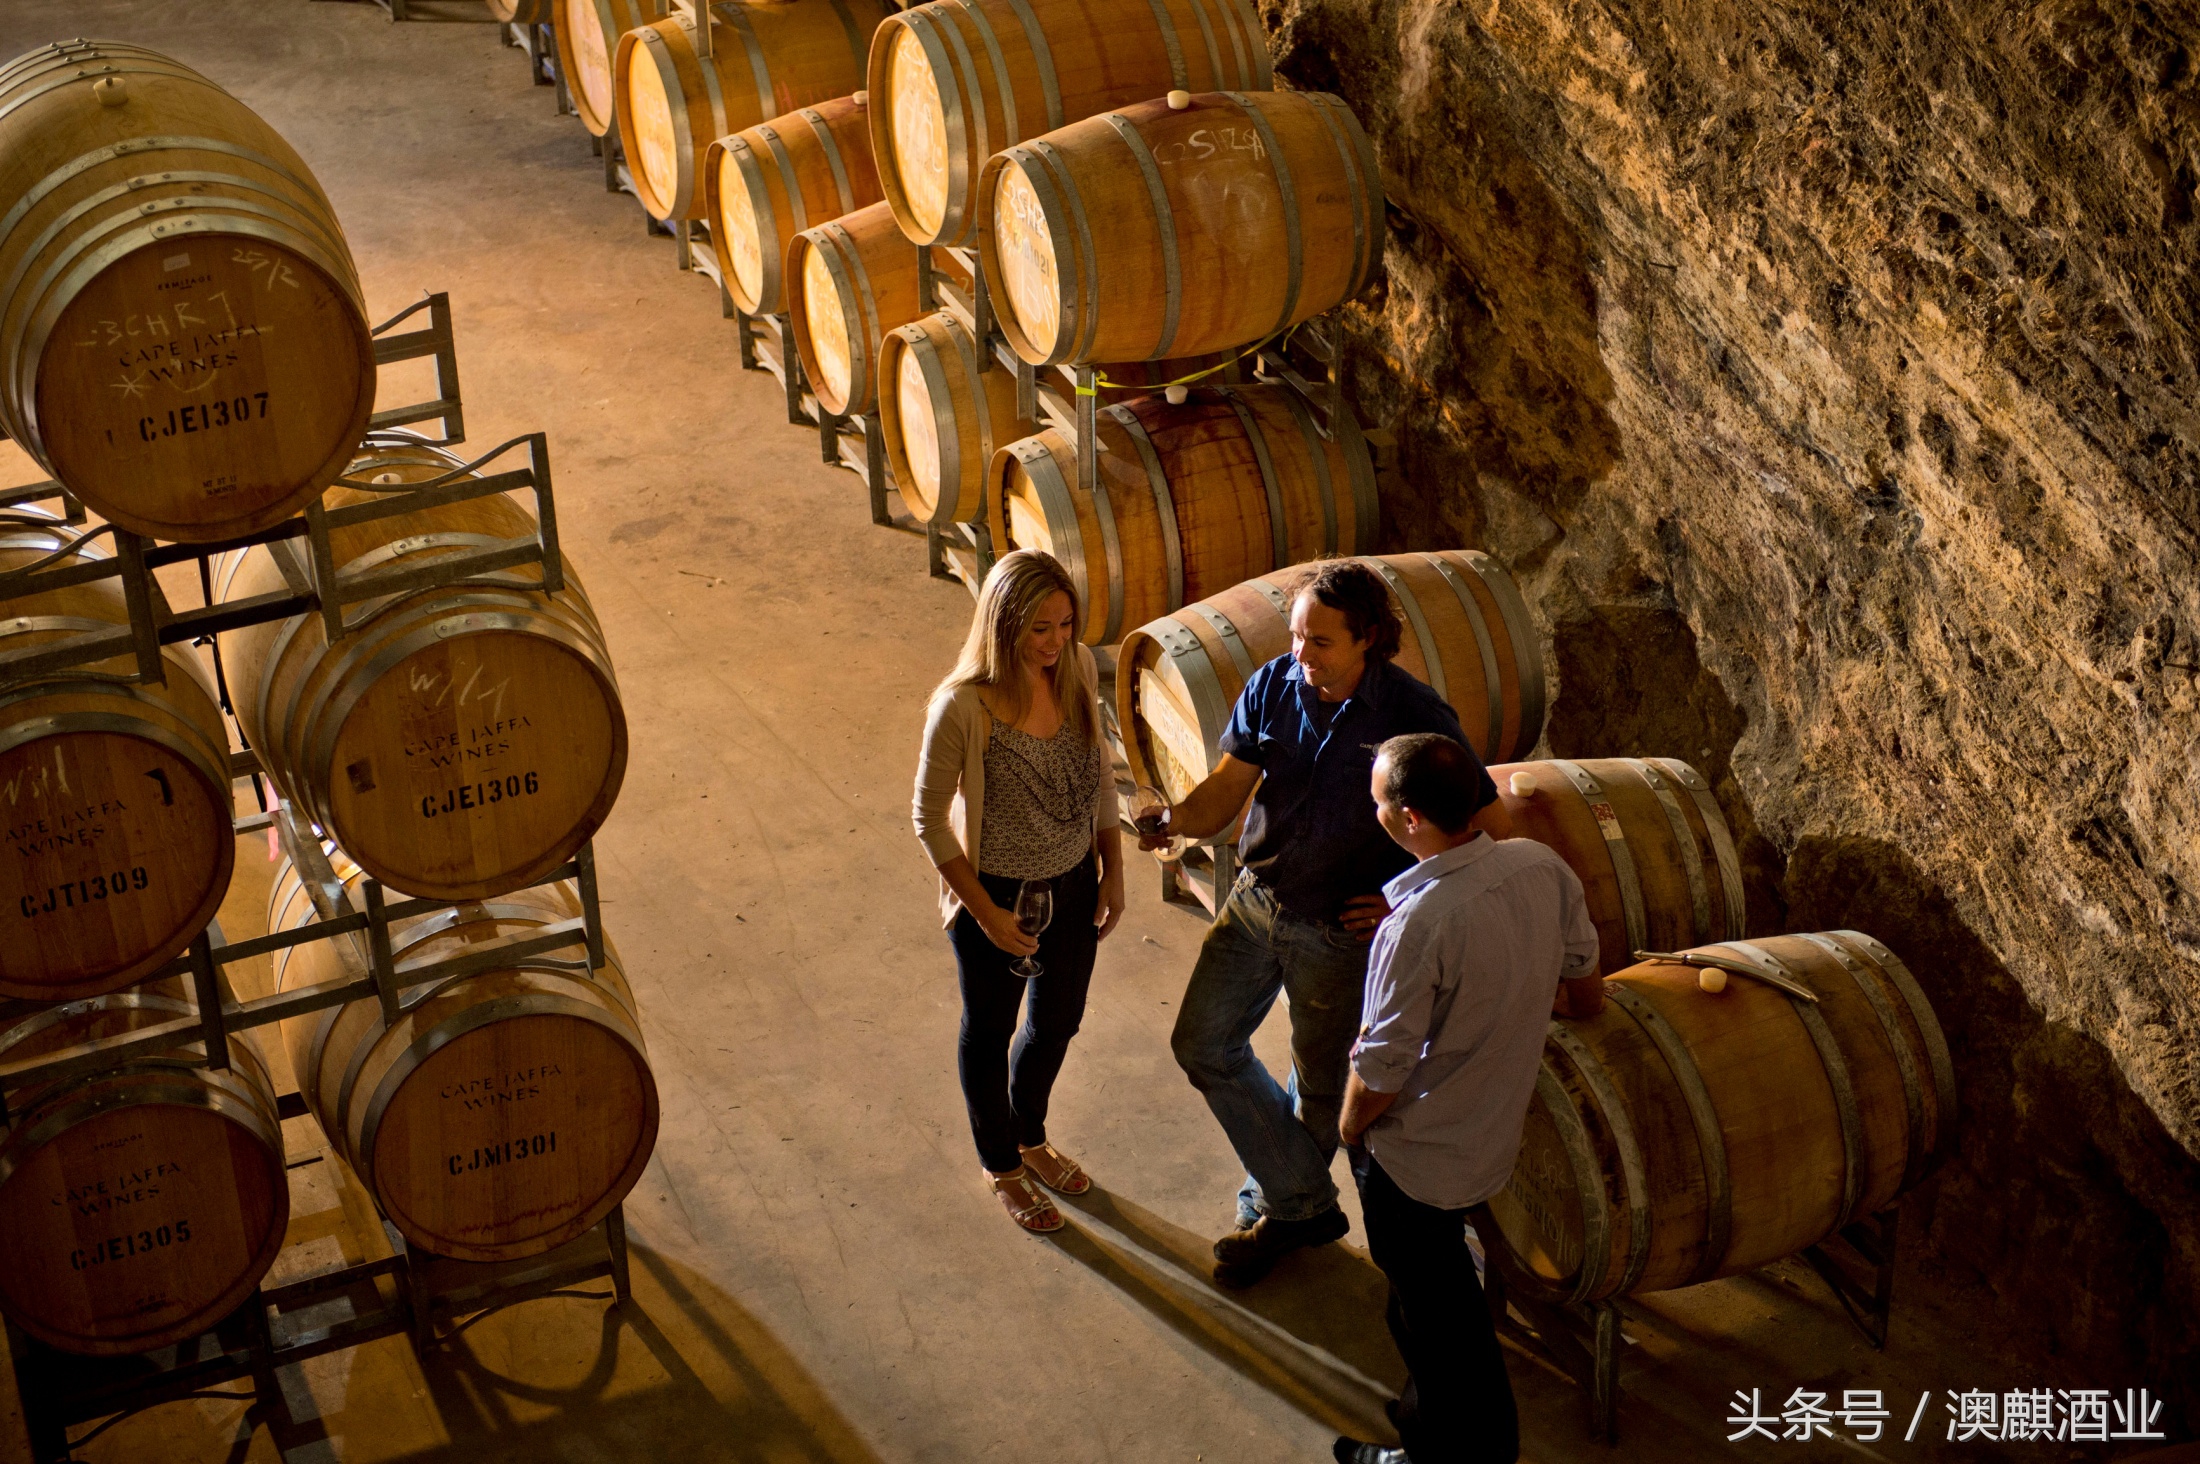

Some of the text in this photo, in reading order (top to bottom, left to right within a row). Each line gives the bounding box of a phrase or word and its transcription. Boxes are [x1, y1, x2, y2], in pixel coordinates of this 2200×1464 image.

[157, 274, 212, 291] ERMITAGE
[119, 324, 262, 368] CAPE JAFFA
[148, 350, 239, 382] WINES
[404, 715, 532, 757] CAPE JAFFA
[430, 739, 510, 768] WINES
[4, 799, 128, 844] APE JAFFA
[18, 824, 106, 858] WINES
[440, 1064, 563, 1100] CAPE JAFFA
[463, 1084, 541, 1111] WINES
[51, 1161, 182, 1206] CAPE JAFFA
[76, 1184, 161, 1217] WINES
